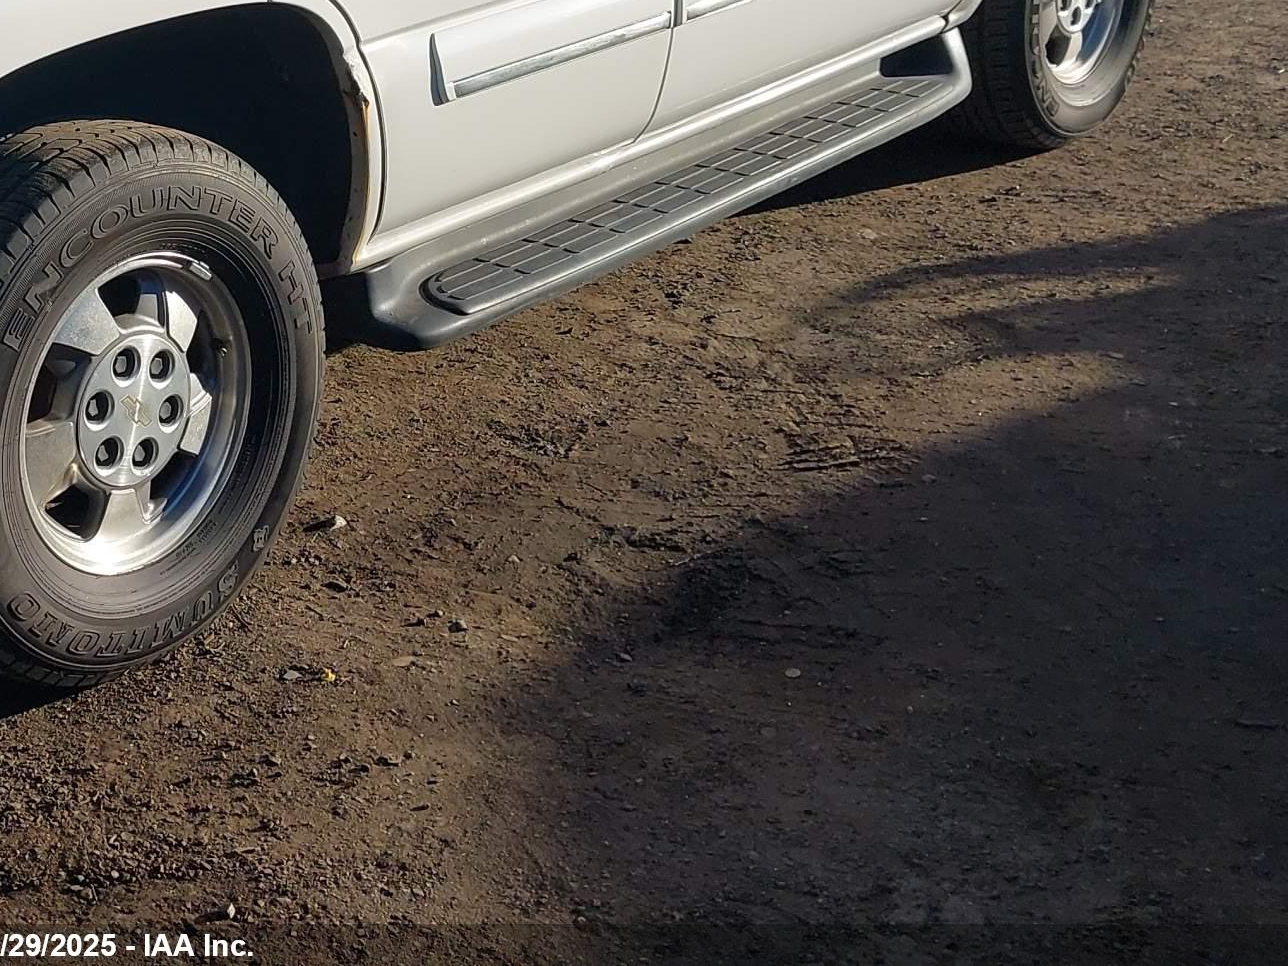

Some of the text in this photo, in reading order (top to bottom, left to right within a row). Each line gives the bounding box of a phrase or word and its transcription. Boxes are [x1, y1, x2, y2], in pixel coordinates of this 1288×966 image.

[2, 185, 314, 352] ENCOUNTER HT
[6, 560, 240, 658] SUMITOMO
